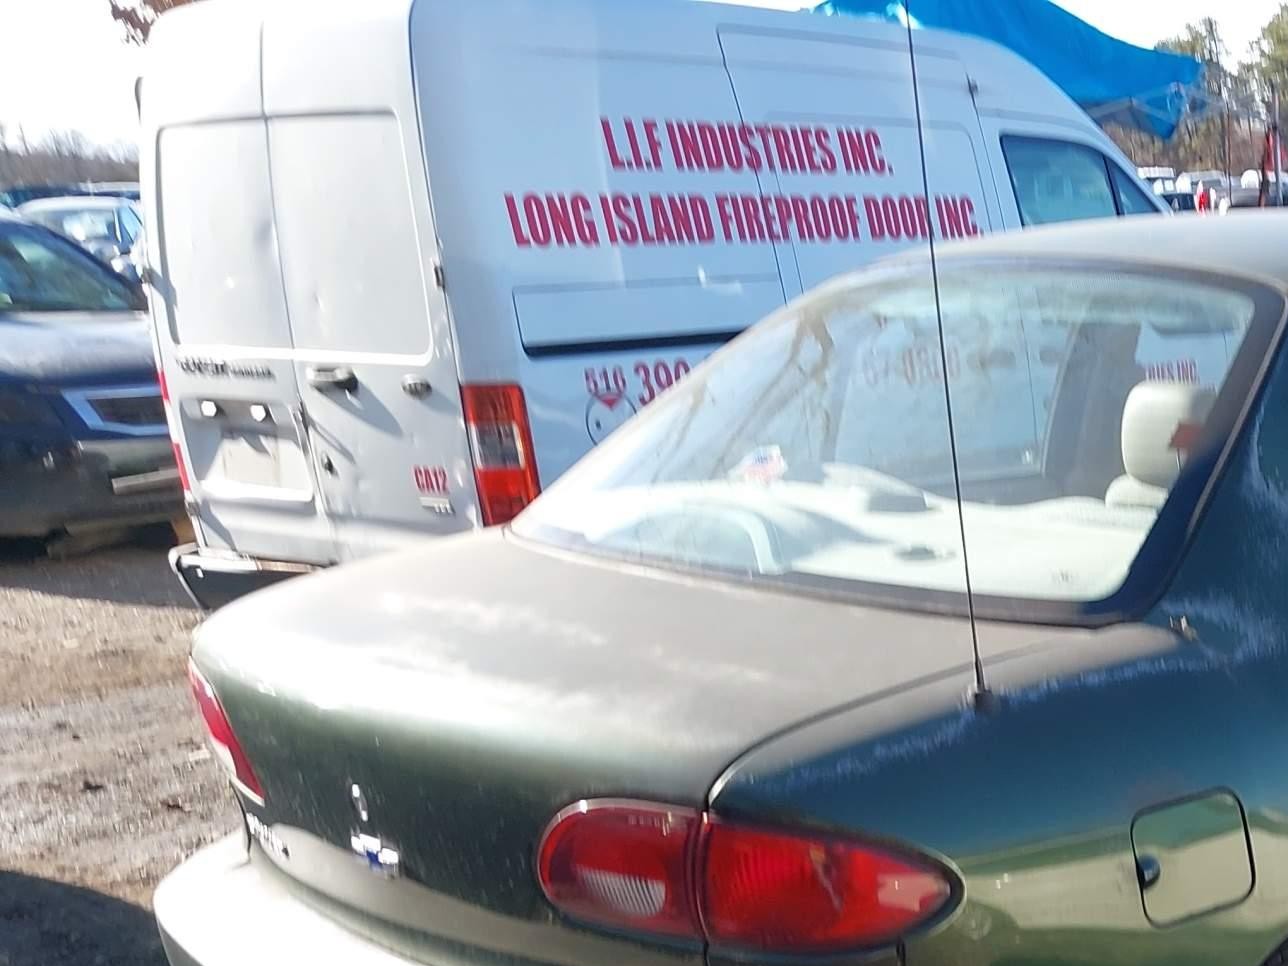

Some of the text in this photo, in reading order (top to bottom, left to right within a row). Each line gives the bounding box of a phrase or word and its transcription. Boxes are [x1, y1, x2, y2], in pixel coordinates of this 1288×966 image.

[600, 116, 894, 175] L.I.F INDUSTRIES INC.
[503, 192, 600, 248] LONG
[599, 192, 715, 247] ISLAND
[714, 192, 860, 245] FIREPROOF
[934, 193, 984, 240] INC.
